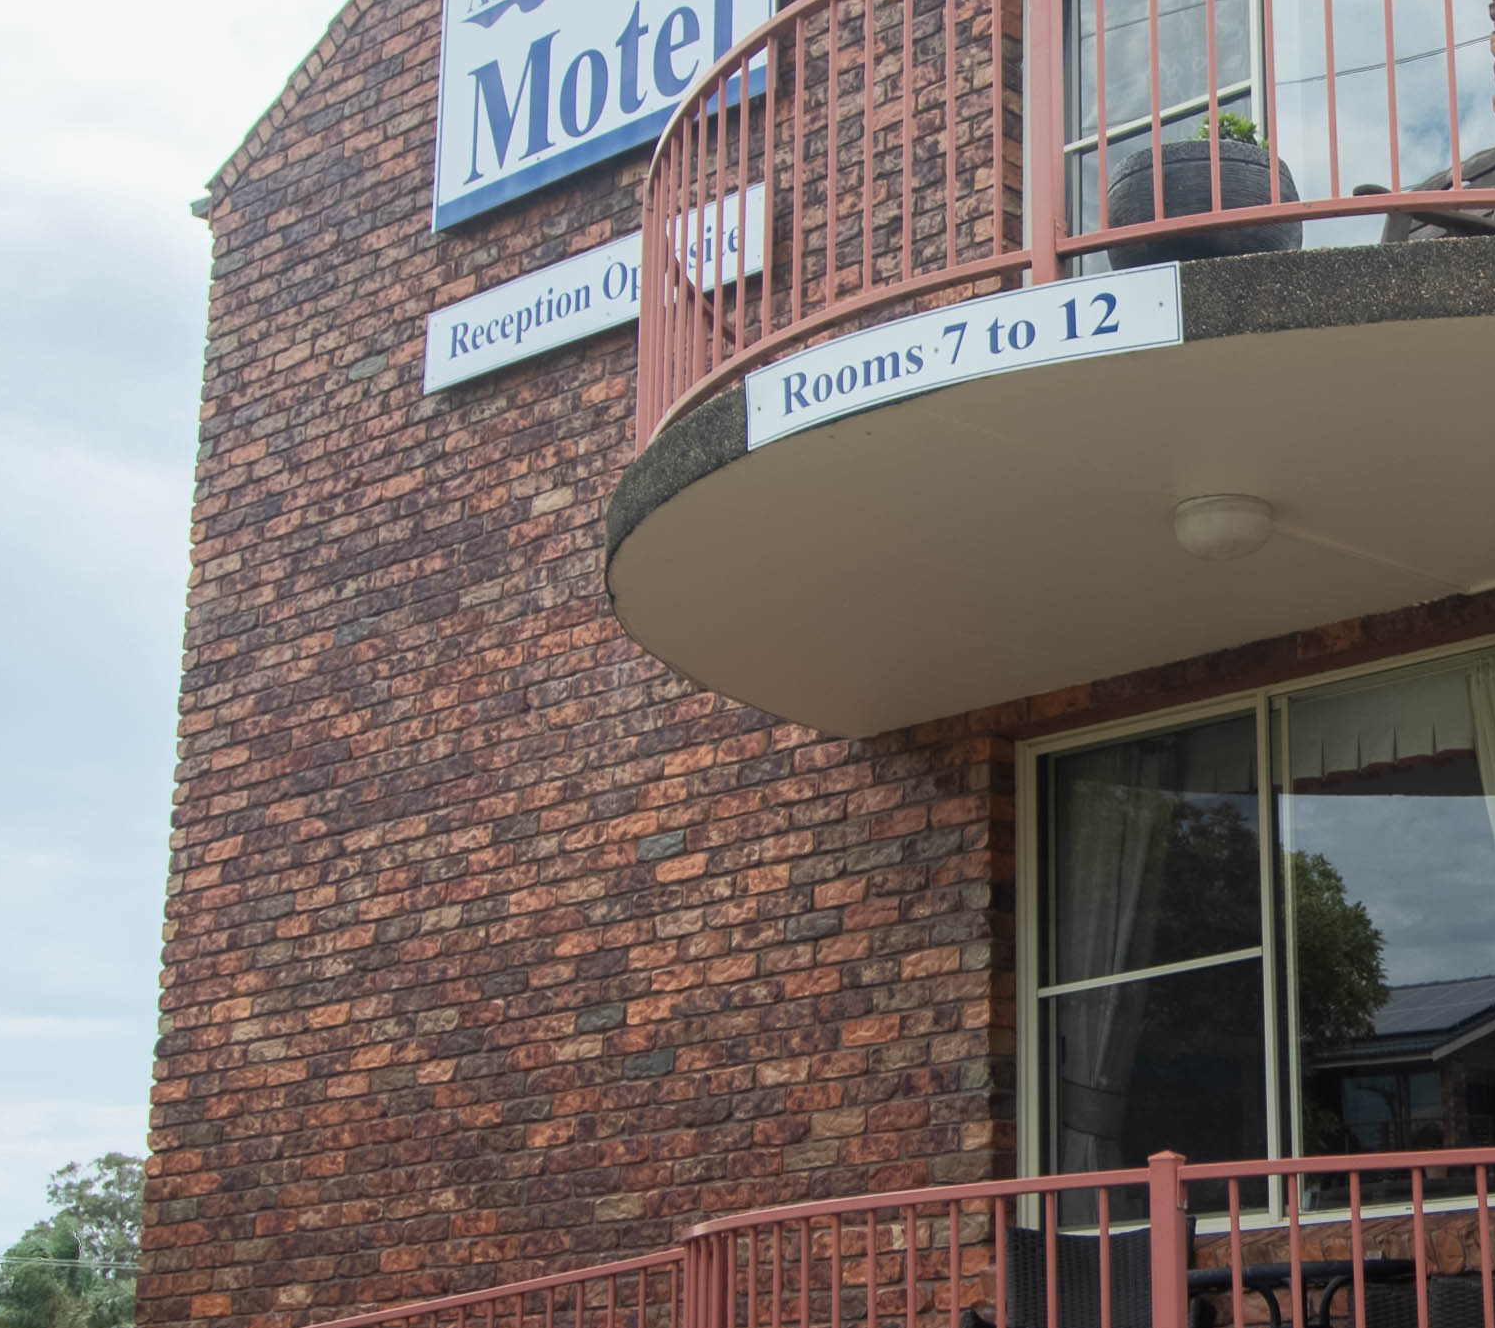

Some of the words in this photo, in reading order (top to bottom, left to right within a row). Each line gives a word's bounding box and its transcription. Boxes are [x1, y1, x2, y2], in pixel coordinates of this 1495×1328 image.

[449, 283, 591, 360] Reception
[781, 343, 924, 416] Rooms
[941, 321, 969, 365] 7
[987, 316, 1036, 355] to
[1058, 292, 1120, 342] 12
